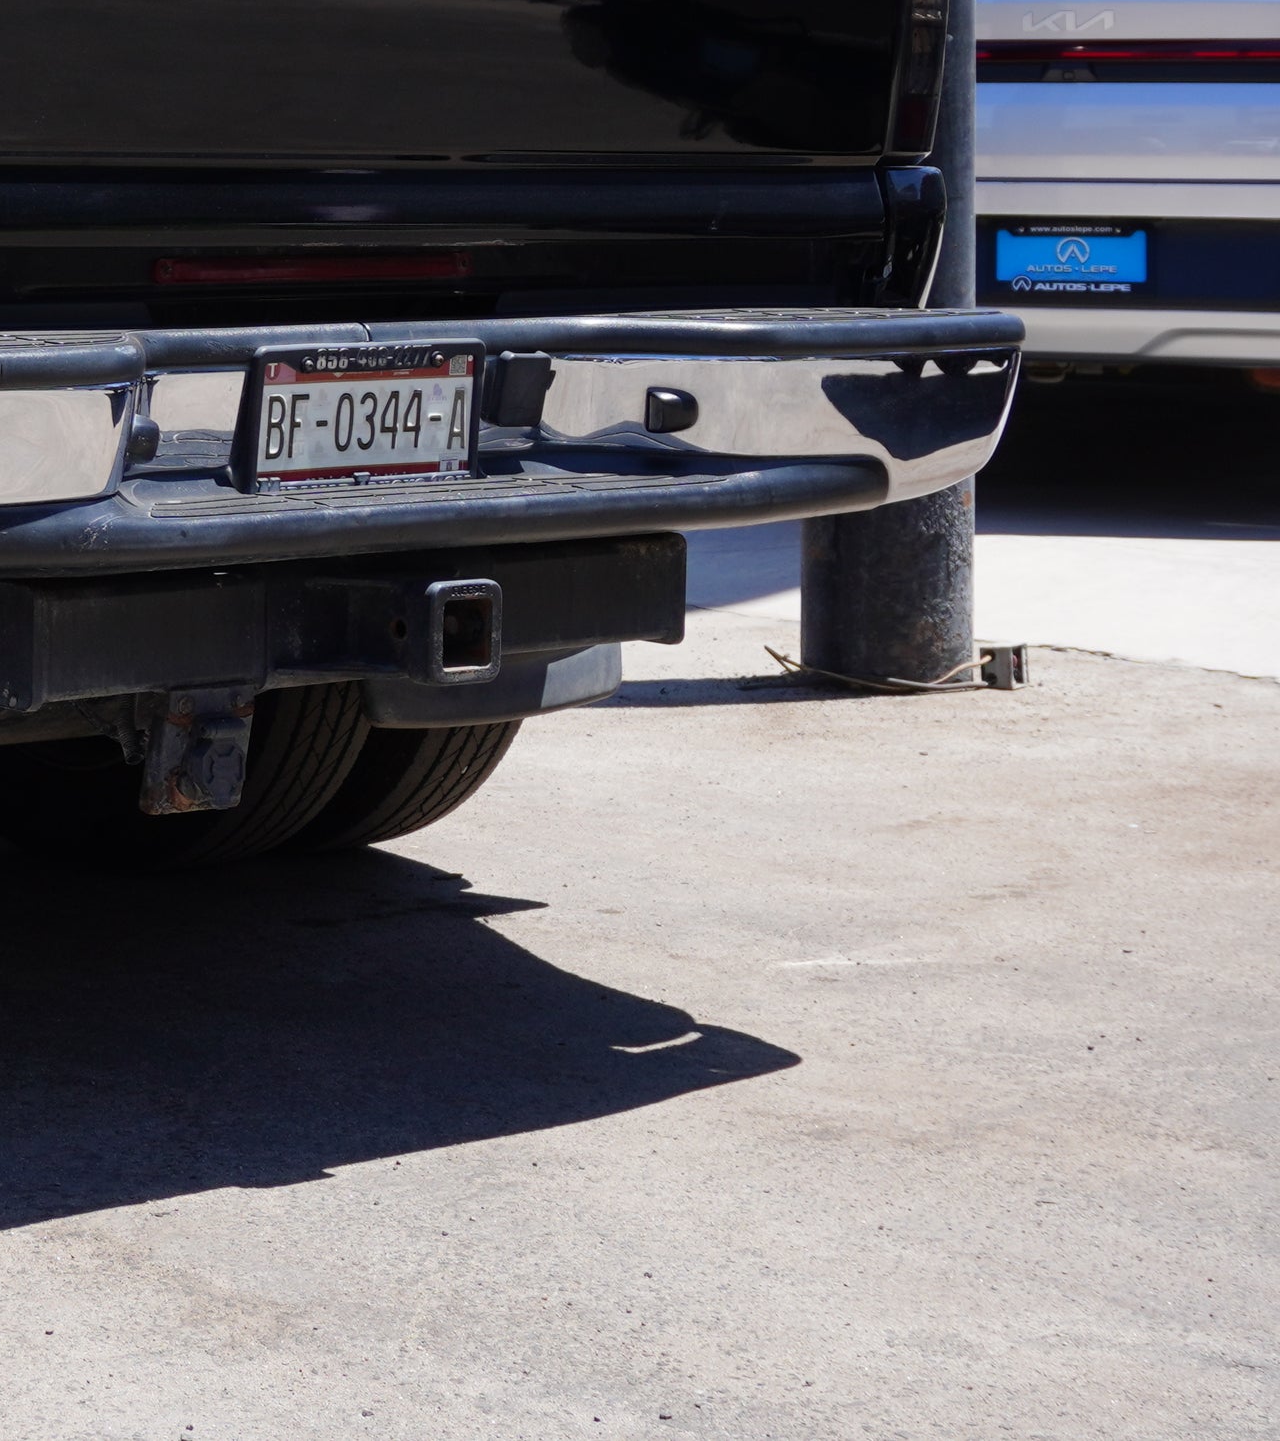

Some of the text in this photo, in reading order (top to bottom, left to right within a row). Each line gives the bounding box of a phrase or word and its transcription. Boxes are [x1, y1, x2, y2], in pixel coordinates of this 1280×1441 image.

[1022, 9, 1115, 31] KIA
[1030, 225, 1113, 233] www.autoslepe.com
[1026, 264, 1118, 273] AUTOS LEPE
[265, 388, 465, 459] BF-0344-A
